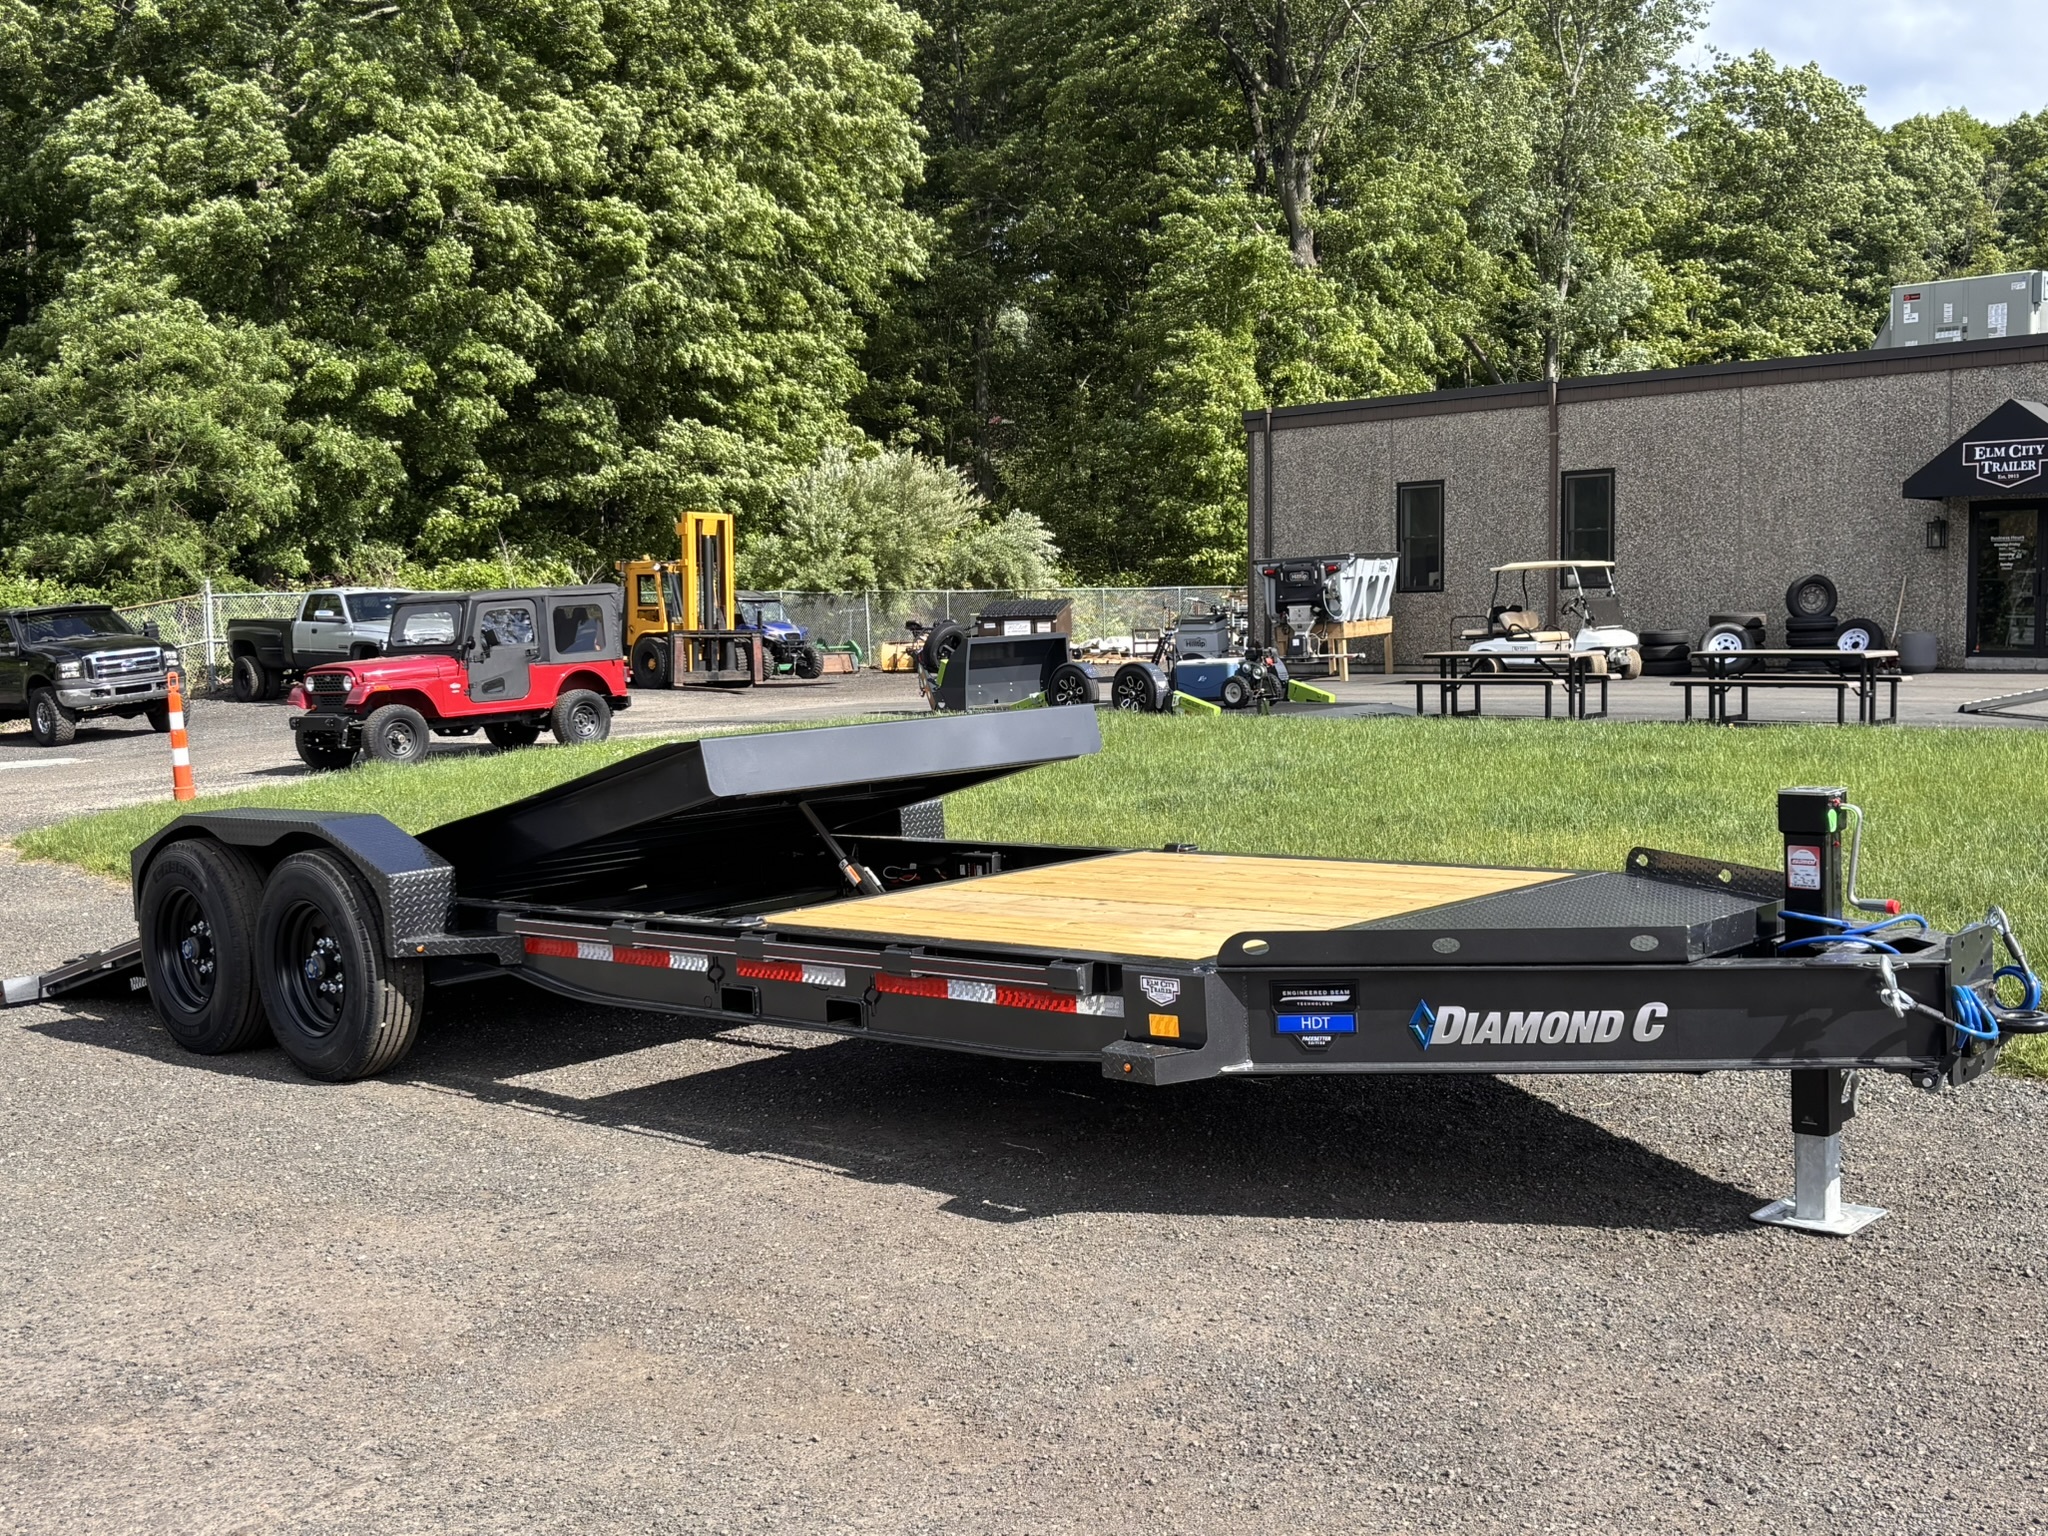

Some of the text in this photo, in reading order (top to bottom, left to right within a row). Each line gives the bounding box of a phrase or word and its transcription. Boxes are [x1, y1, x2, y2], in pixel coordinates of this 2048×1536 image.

[1974, 444, 2045, 460] ELM CITY
[1981, 460, 2037, 474] TRAILER
[1160, 980, 1175, 988] CITY
[1301, 1016, 1331, 1029] HDT
[1429, 1001, 1669, 1045] DIAMOND C
